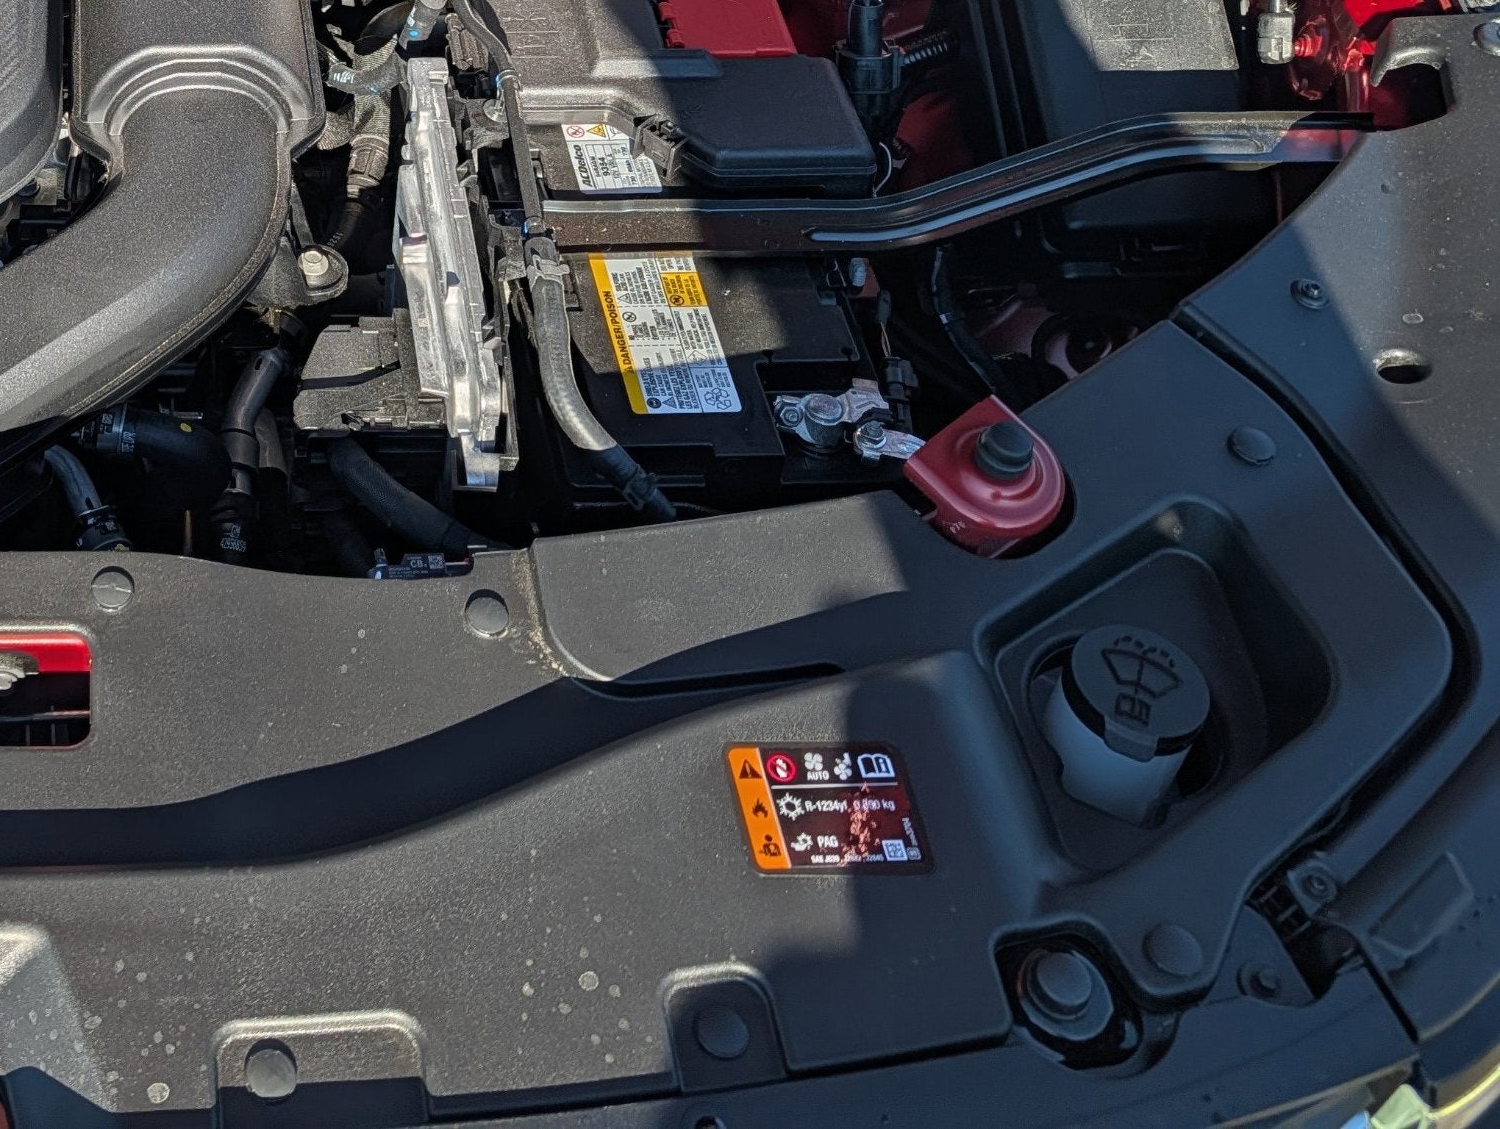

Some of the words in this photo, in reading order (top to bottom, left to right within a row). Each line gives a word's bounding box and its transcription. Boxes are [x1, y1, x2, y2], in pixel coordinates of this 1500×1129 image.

[573, 145, 592, 186] ACDelco
[604, 291, 631, 365] DANGER/POISON
[807, 771, 829, 781] AUTO
[882, 800, 895, 812] kg
[817, 836, 838, 848] PAG
